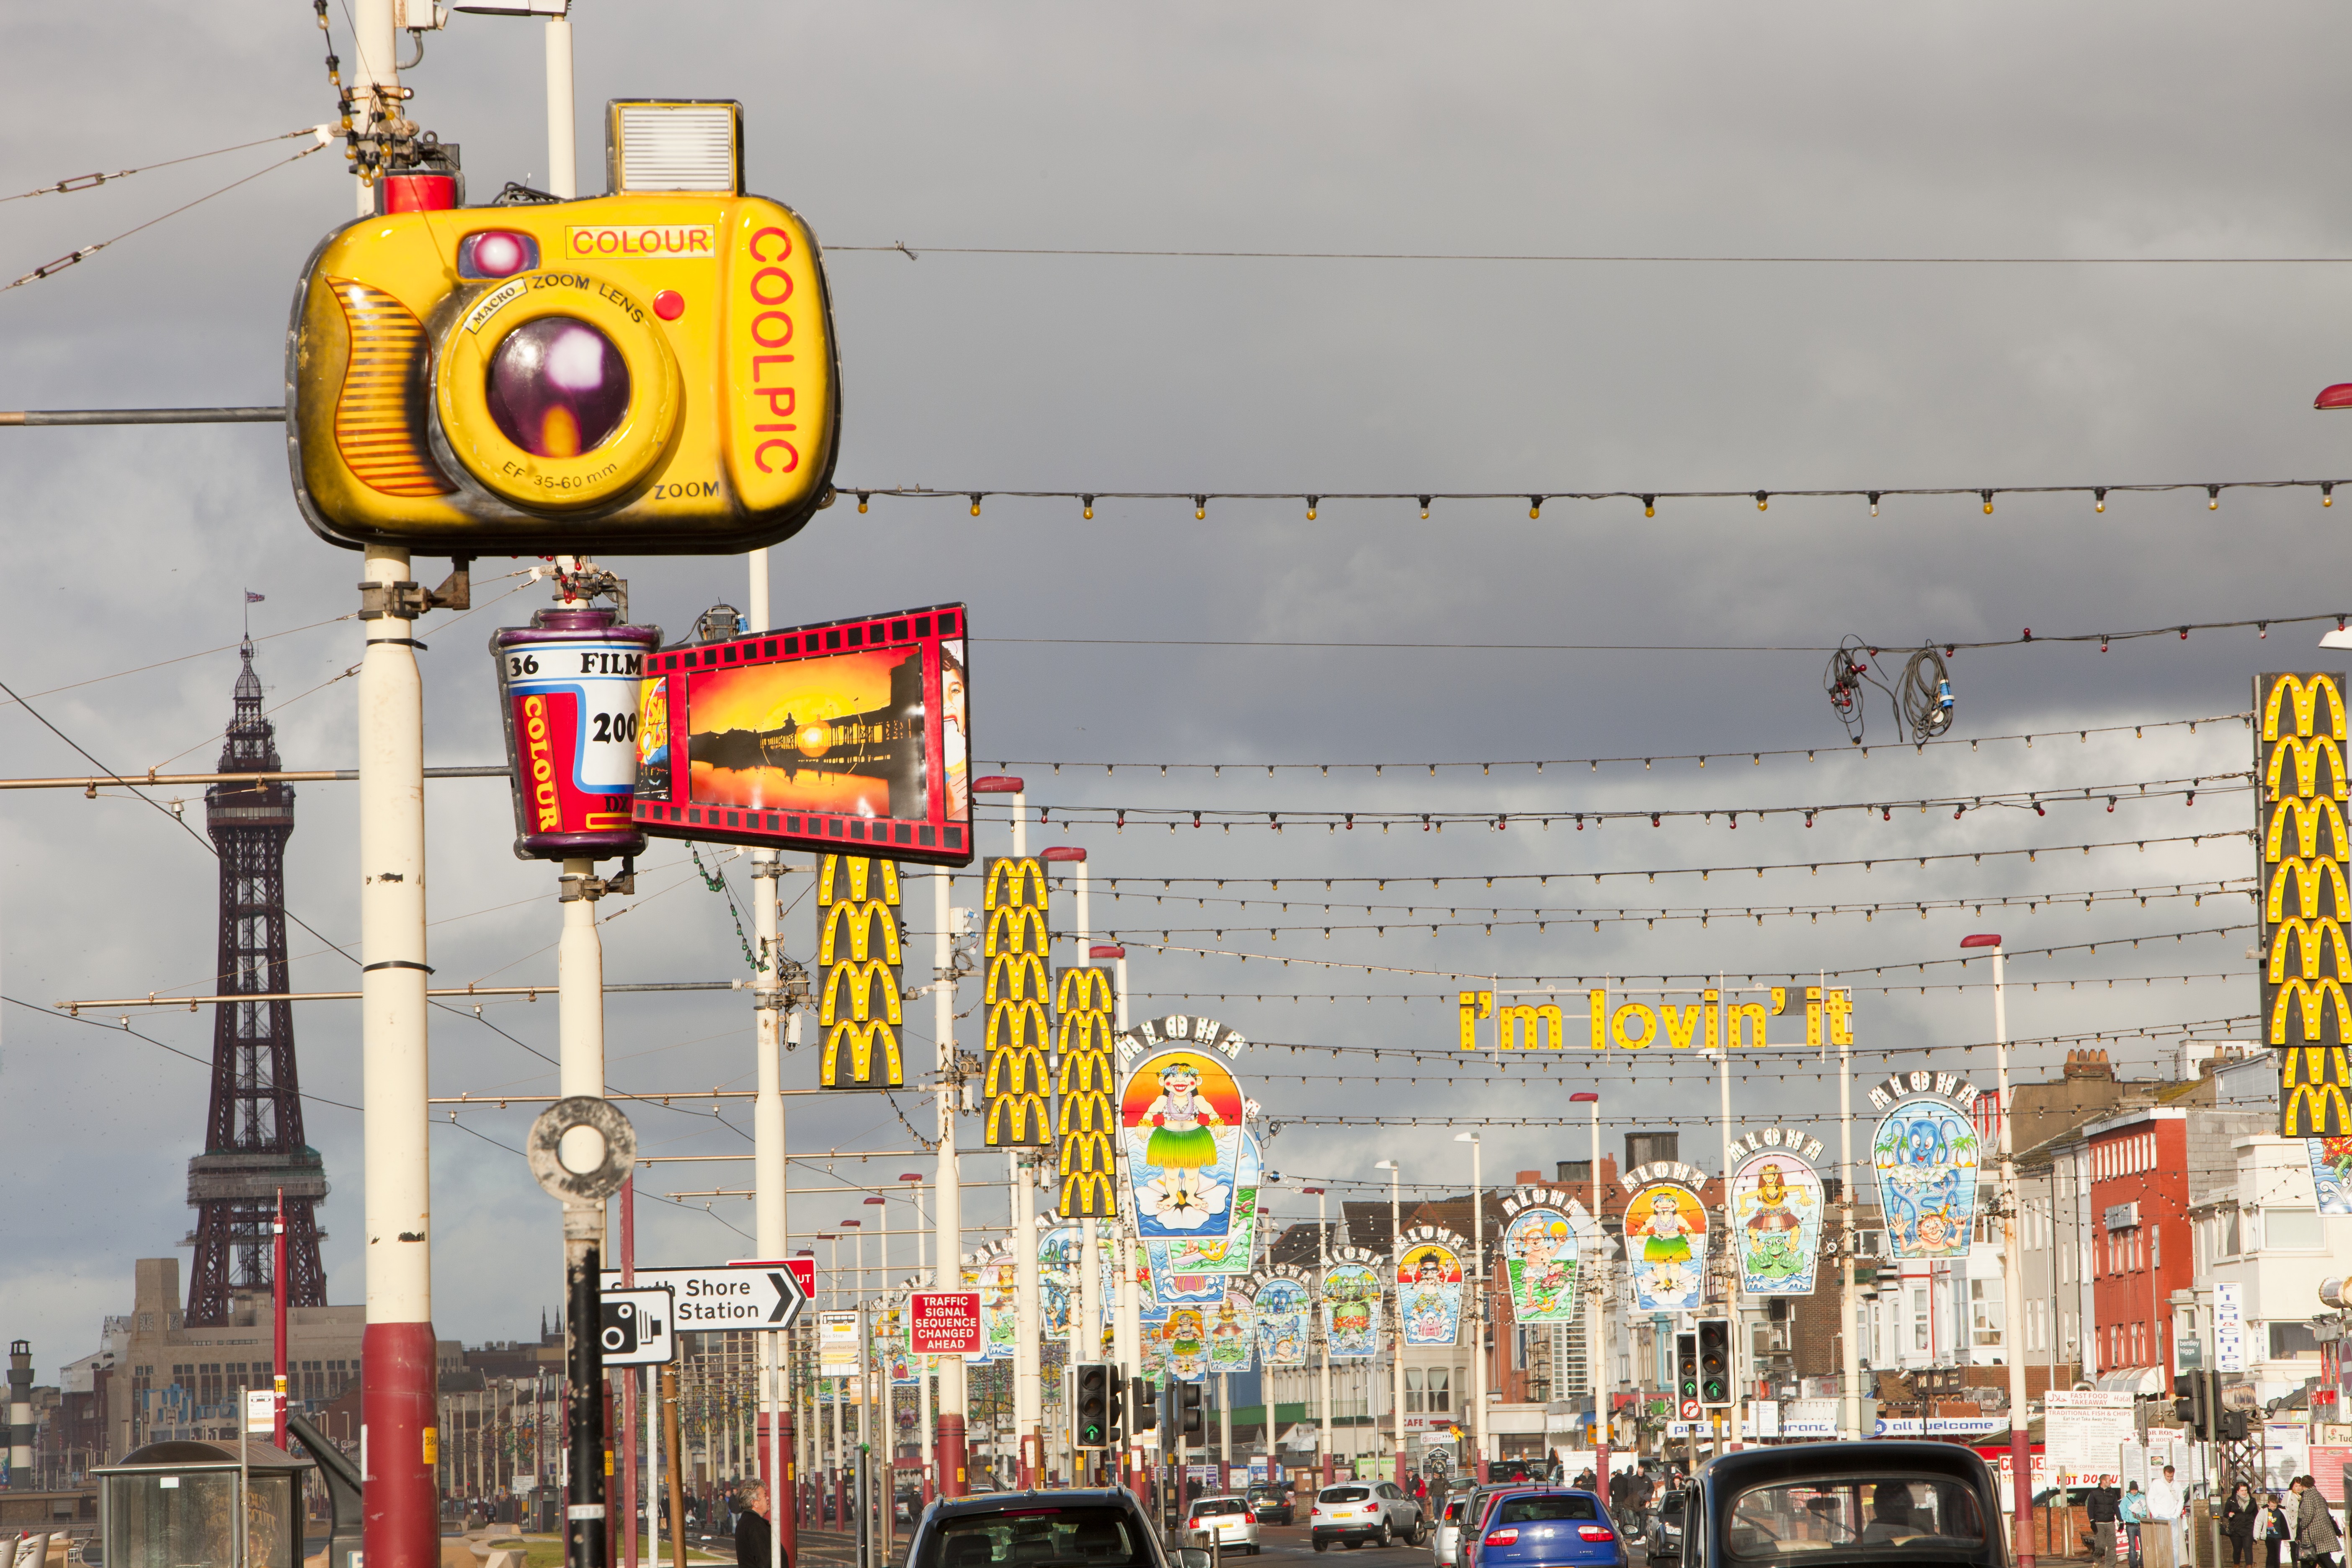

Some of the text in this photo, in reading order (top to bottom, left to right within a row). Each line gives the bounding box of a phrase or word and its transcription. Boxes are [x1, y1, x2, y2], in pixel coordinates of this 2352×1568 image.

[572, 229, 709, 254] COLOUR
[472, 285, 516, 326] MACRO
[532, 275, 644, 324] ZOOM LENS
[749, 226, 799, 474] COOLPIC
[502, 460, 618, 489] EF 35-60 mm
[654, 481, 720, 500] ZOOM
[510, 652, 642, 677] 36 FILM
[593, 712, 636, 744] 200
[524, 695, 559, 832] COLOUR
[604, 794, 631, 814] DX
[1459, 986, 1853, 1050] i'm lovin' it
[1115, 1015, 1246, 1063] ALOHA
[1866, 1071, 1981, 1111] ALOHA
[1726, 1127, 1826, 1163] ALOHA
[1620, 1161, 1708, 1194] ALOHA
[1501, 1189, 1581, 1217] ALOHA
[1393, 1225, 1466, 1251] ALOHA
[685, 1279, 751, 1297] Shore
[923, 1297, 969, 1306] TRAFFIC
[678, 1302, 759, 1320] Station
[925, 1308, 967, 1317] SIGNAL
[2219, 1284, 2239, 1320] FISH
[915, 1318, 977, 1328] SEQUENCE
[918, 1328, 974, 1338] CHANGED
[927, 1339, 966, 1349] AHEAD
[2218, 1328, 2239, 1371] CHIPS
[1893, 1421, 1913, 1430] all
[1919, 1421, 1994, 1430] welcome
[426, 1436, 437, 1446] 384
